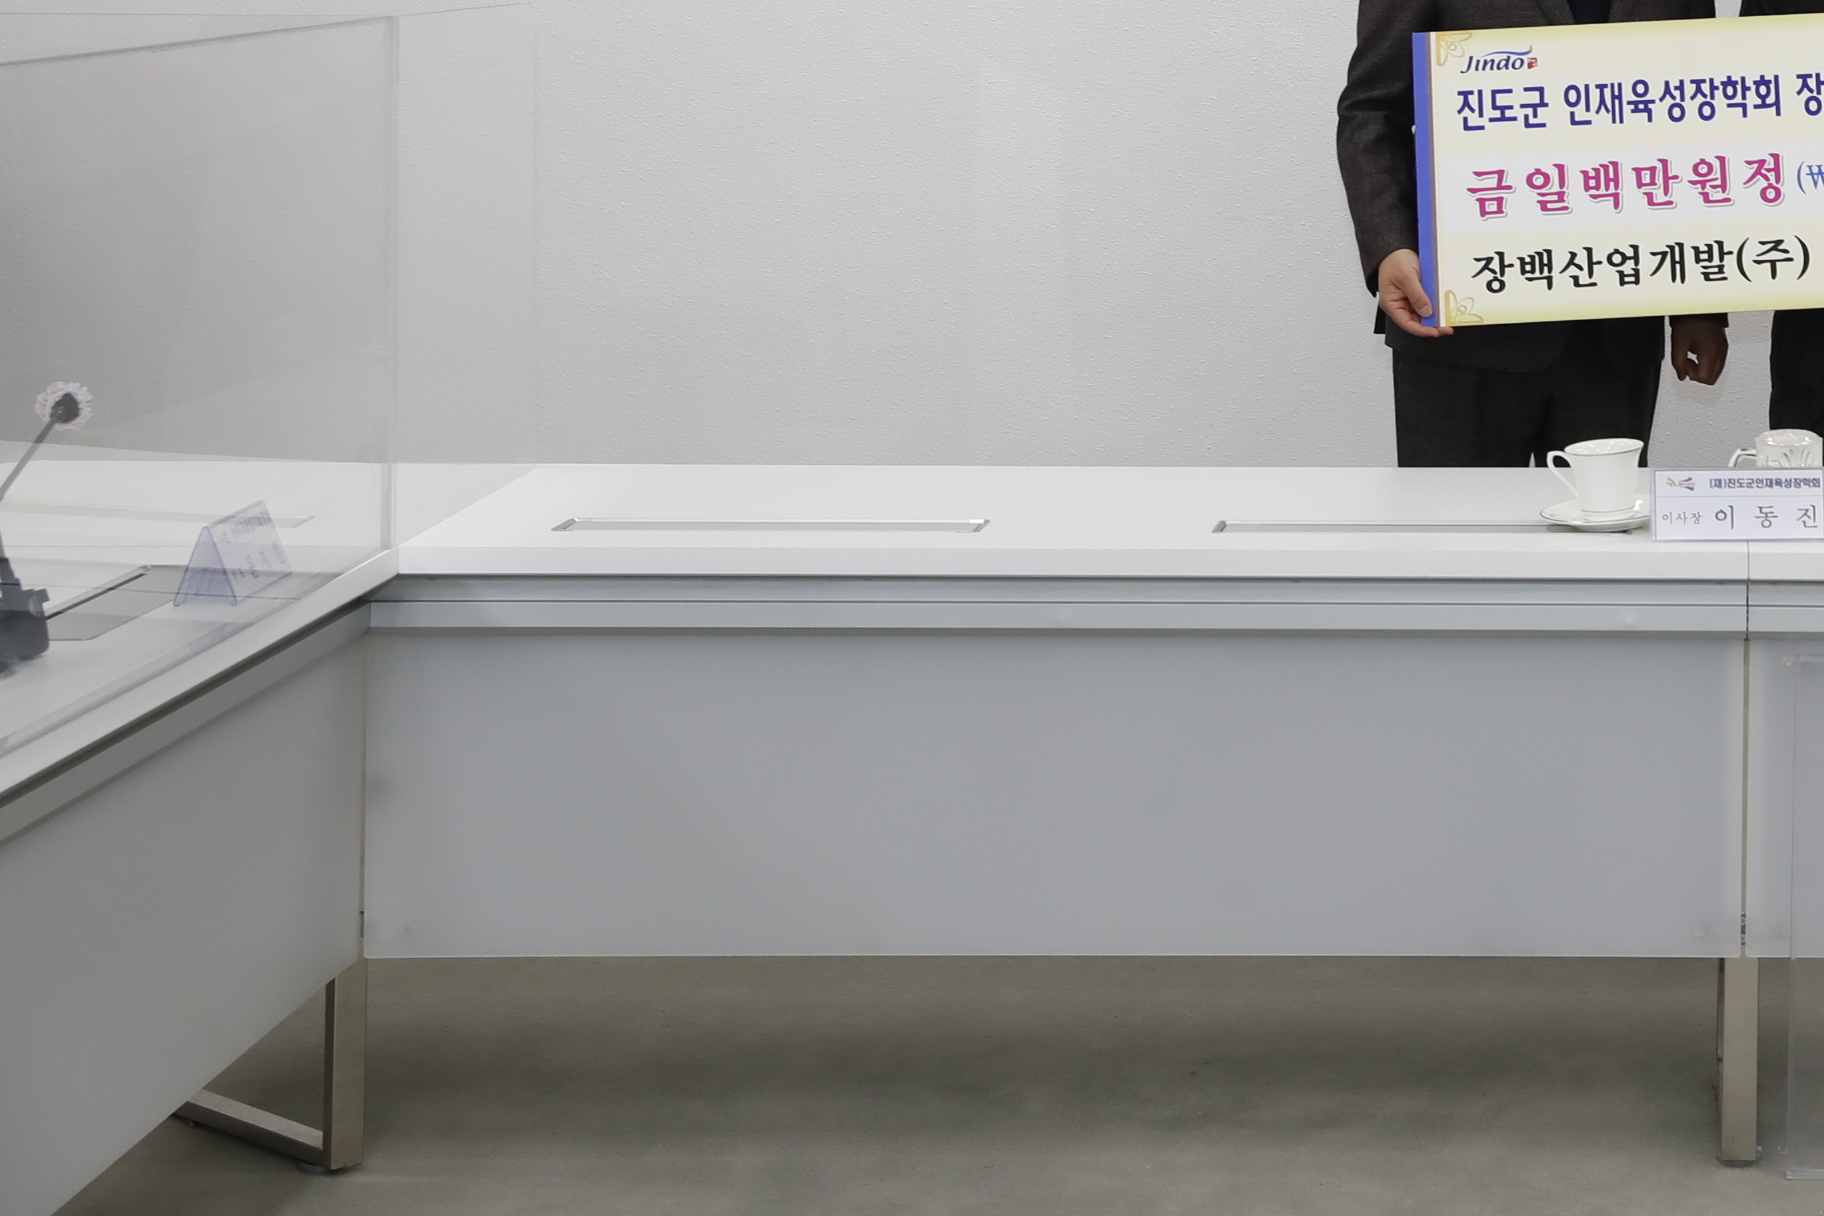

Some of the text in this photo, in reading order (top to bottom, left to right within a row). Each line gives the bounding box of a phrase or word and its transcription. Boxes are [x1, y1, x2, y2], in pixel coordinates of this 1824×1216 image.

[1460, 55, 1525, 74] Jindo
[1456, 85, 1550, 132] 진도군
[1563, 74, 1782, 127] 인재육성장학회
[1471, 234, 1811, 294] 장백산업개발(주)
[1661, 511, 1703, 525] 이사장
